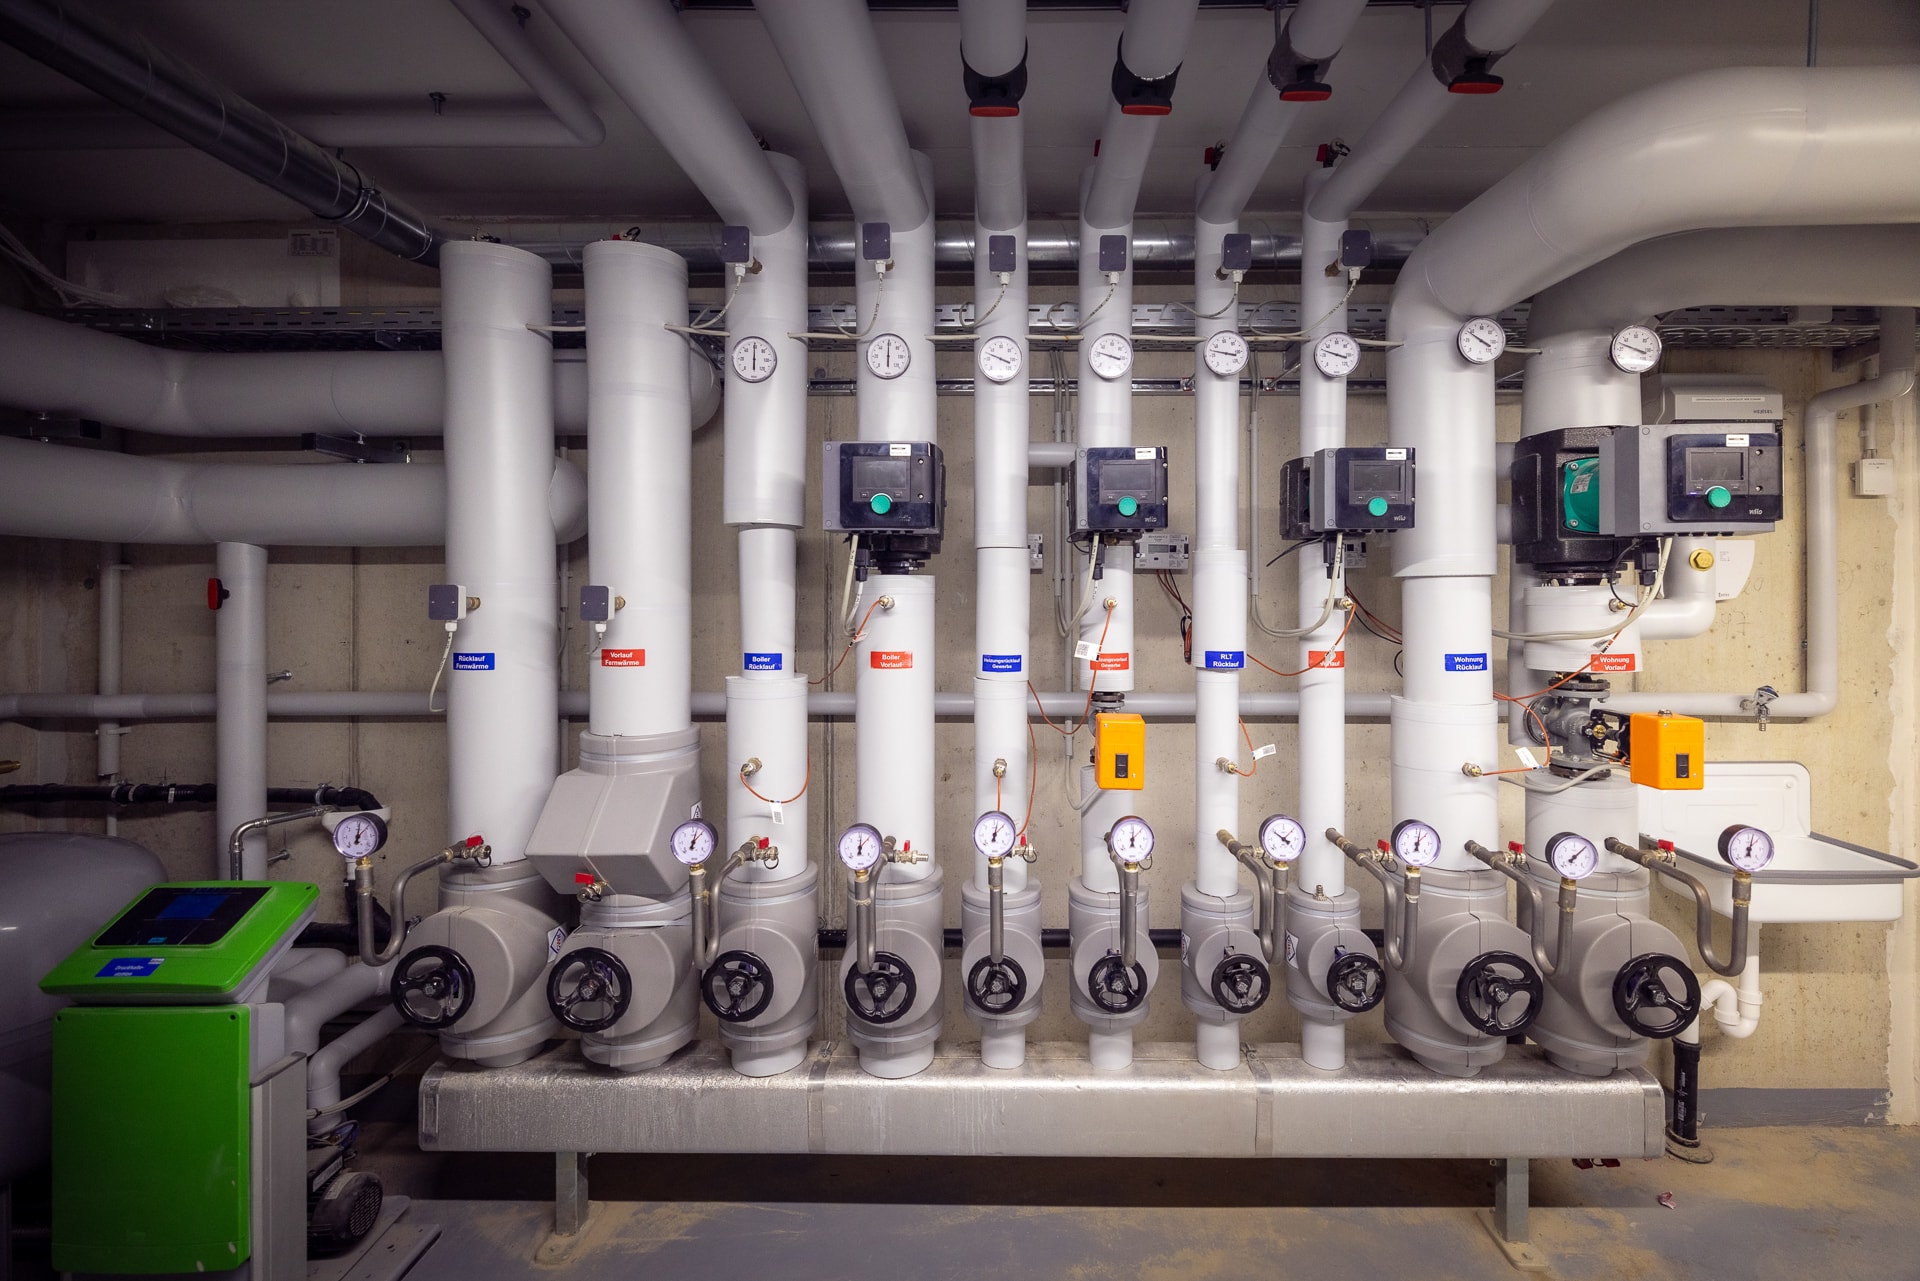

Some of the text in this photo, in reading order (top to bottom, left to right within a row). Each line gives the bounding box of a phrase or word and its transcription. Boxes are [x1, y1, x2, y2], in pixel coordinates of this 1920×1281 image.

[610, 651, 633, 659] Vorlauf
[1600, 656, 1630, 664] Wohnung
[748, 662, 776, 670] Rücklauf
